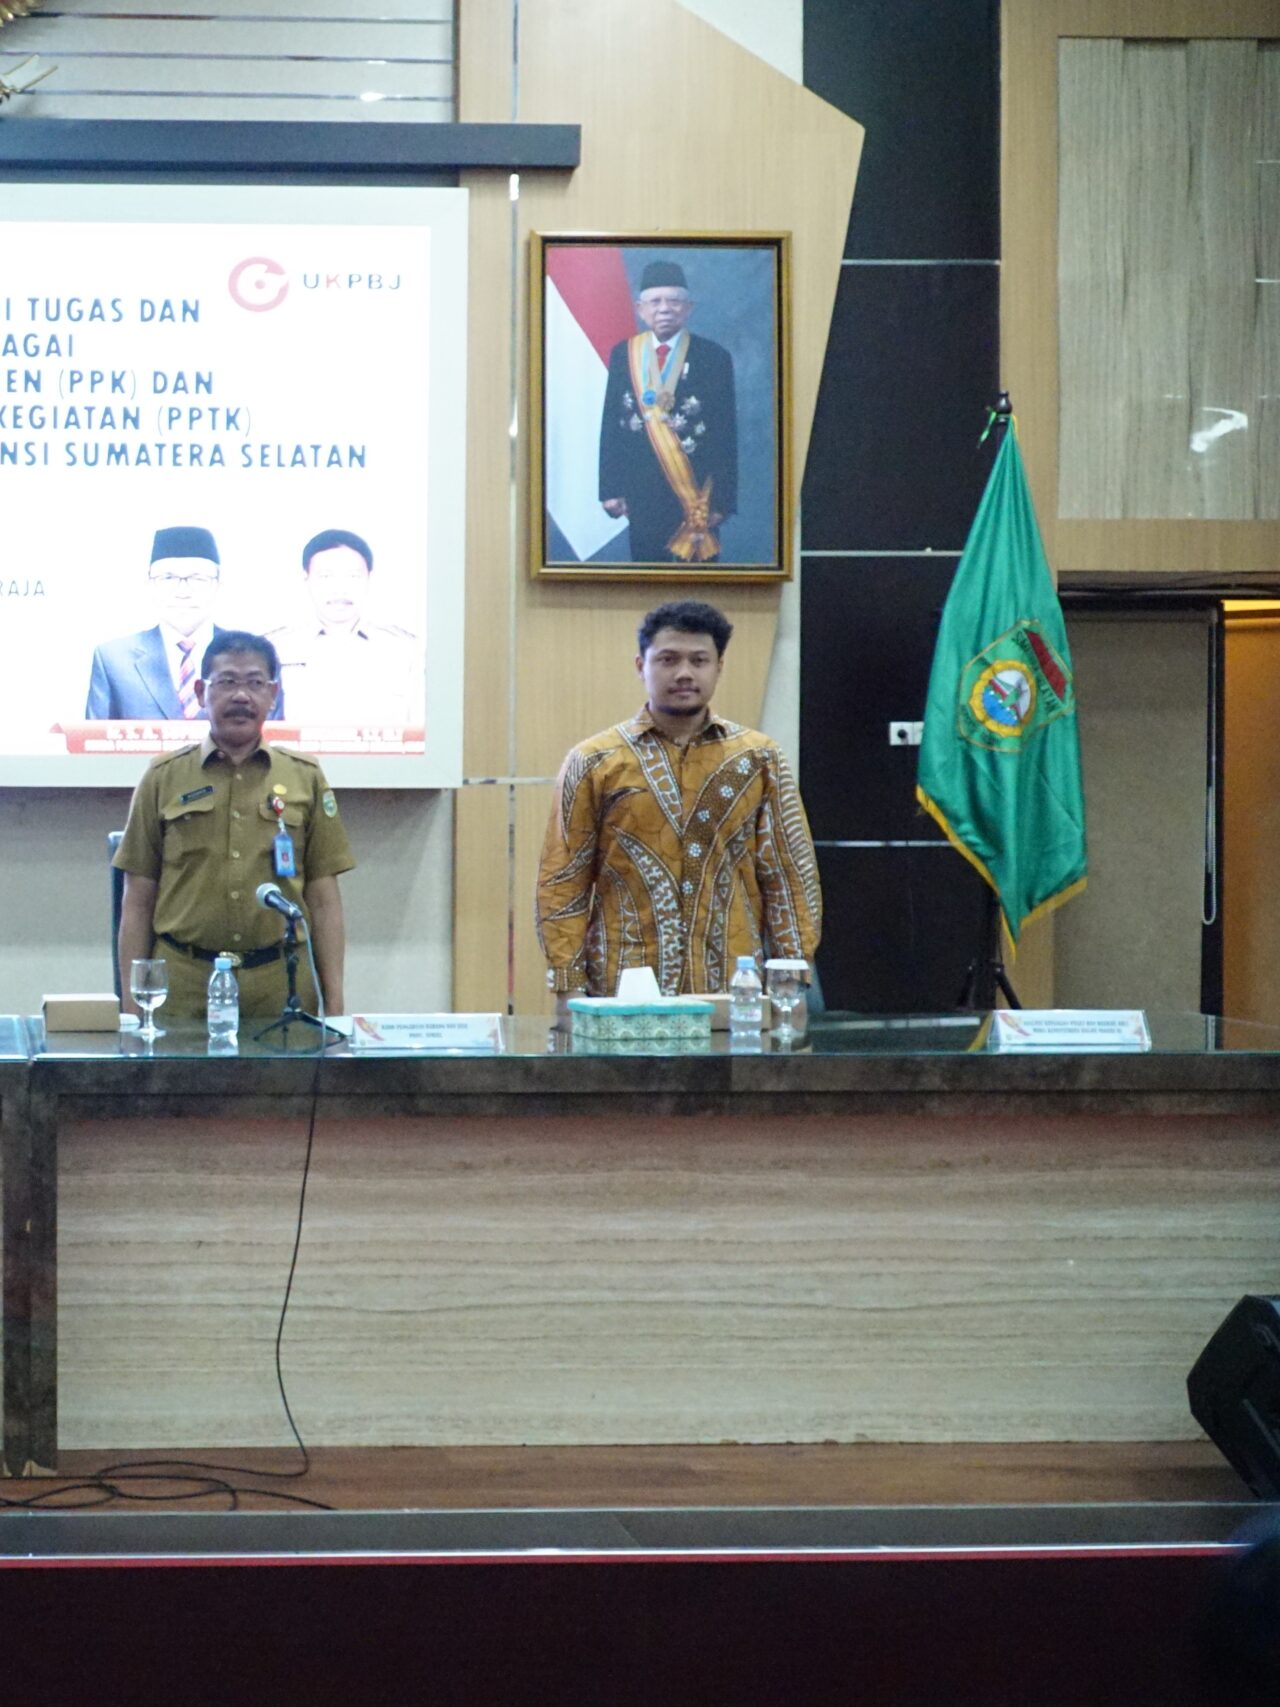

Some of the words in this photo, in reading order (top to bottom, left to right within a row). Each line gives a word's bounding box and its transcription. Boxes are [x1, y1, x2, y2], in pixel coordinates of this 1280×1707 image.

[302, 272, 401, 290] UKPBJ
[26, 296, 124, 323] TUGAS
[139, 297, 200, 324] DAN
[58, 368, 136, 401] (PPK)
[152, 369, 214, 396] DAN
[157, 404, 252, 437] (PPTK)
[64, 441, 226, 468] SUMATERA
[240, 442, 367, 469] SELATAN
